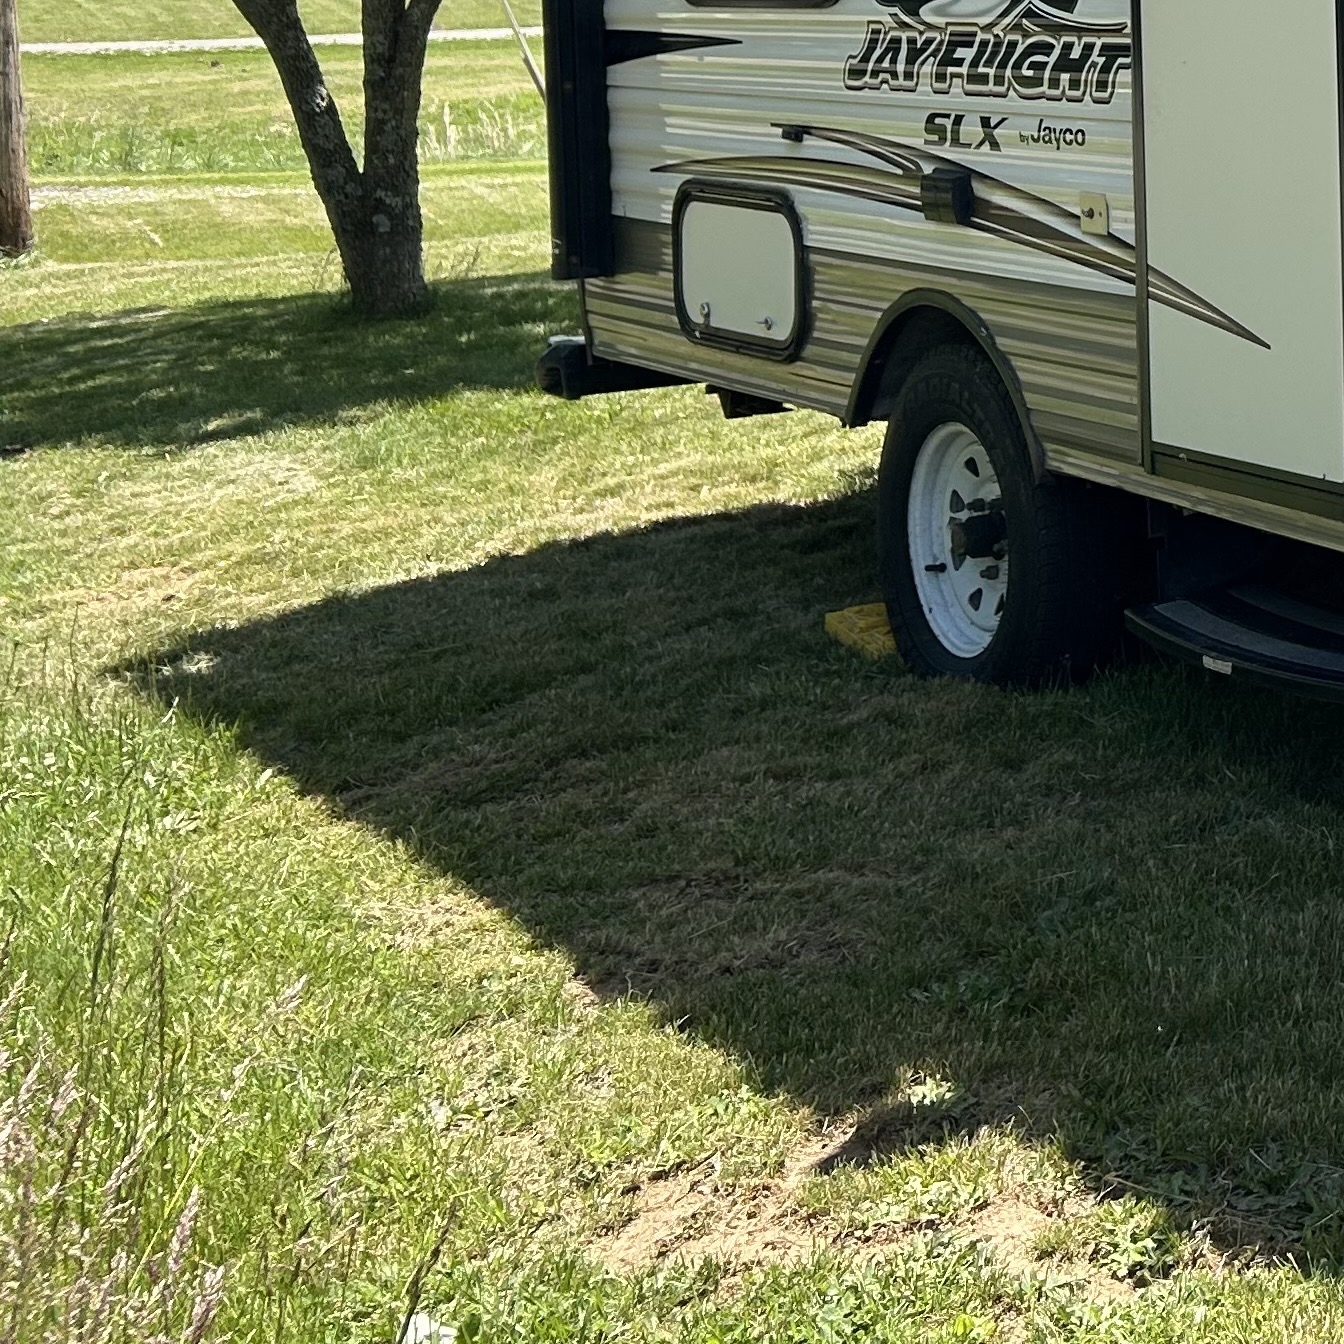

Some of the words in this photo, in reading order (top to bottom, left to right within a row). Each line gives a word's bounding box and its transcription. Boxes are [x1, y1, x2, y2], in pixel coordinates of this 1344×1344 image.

[923, 112, 1009, 152] SLX
[1019, 131, 1030, 146] by
[1030, 118, 1087, 151] Jayco
